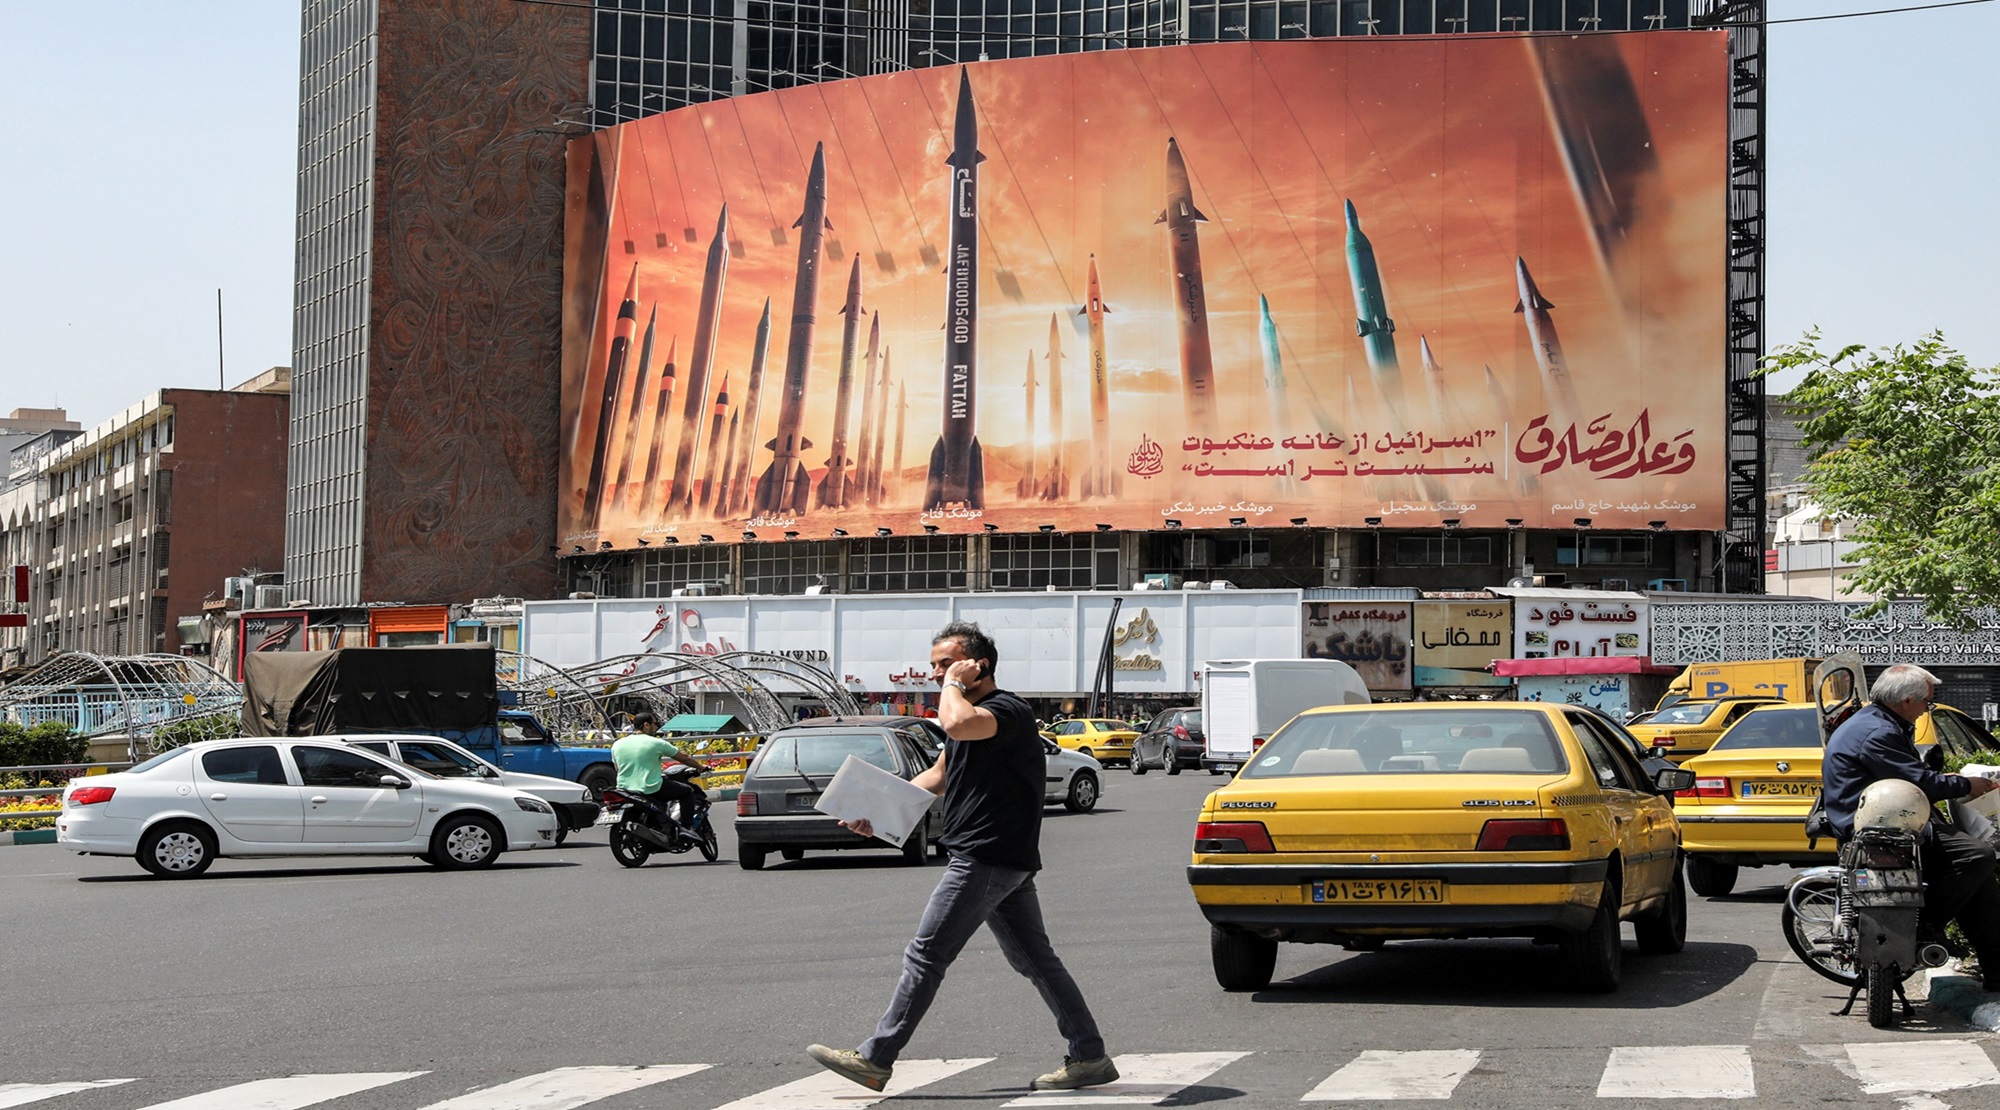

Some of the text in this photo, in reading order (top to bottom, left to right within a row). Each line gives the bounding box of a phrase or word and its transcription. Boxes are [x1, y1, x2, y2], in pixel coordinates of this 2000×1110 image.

[952, 364, 968, 419] FATTAH
[1182, 432, 1274, 455] عنکبوت
[1281, 432, 1345, 450] خانه
[1348, 432, 1368, 455] از
[1300, 459, 1348, 481] تر
[1229, 501, 1274, 516] موشک
[1381, 500, 1477, 515] موشک سجیل
[1551, 499, 1697, 514] موشک شهید حاج قاسم
[745, 515, 796, 532] موشک فاتح
[919, 507, 983, 524] موشک فتاح
[1333, 609, 1407, 623] فروشگاه کفش
[1466, 609, 1504, 619] فروشگاه
[1530, 601, 1637, 627] فست فود
[1893, 643, 1951, 654] Hazrat-e
[1954, 643, 1980, 654] Vali
[1221, 801, 1276, 809] PEUGEOT
